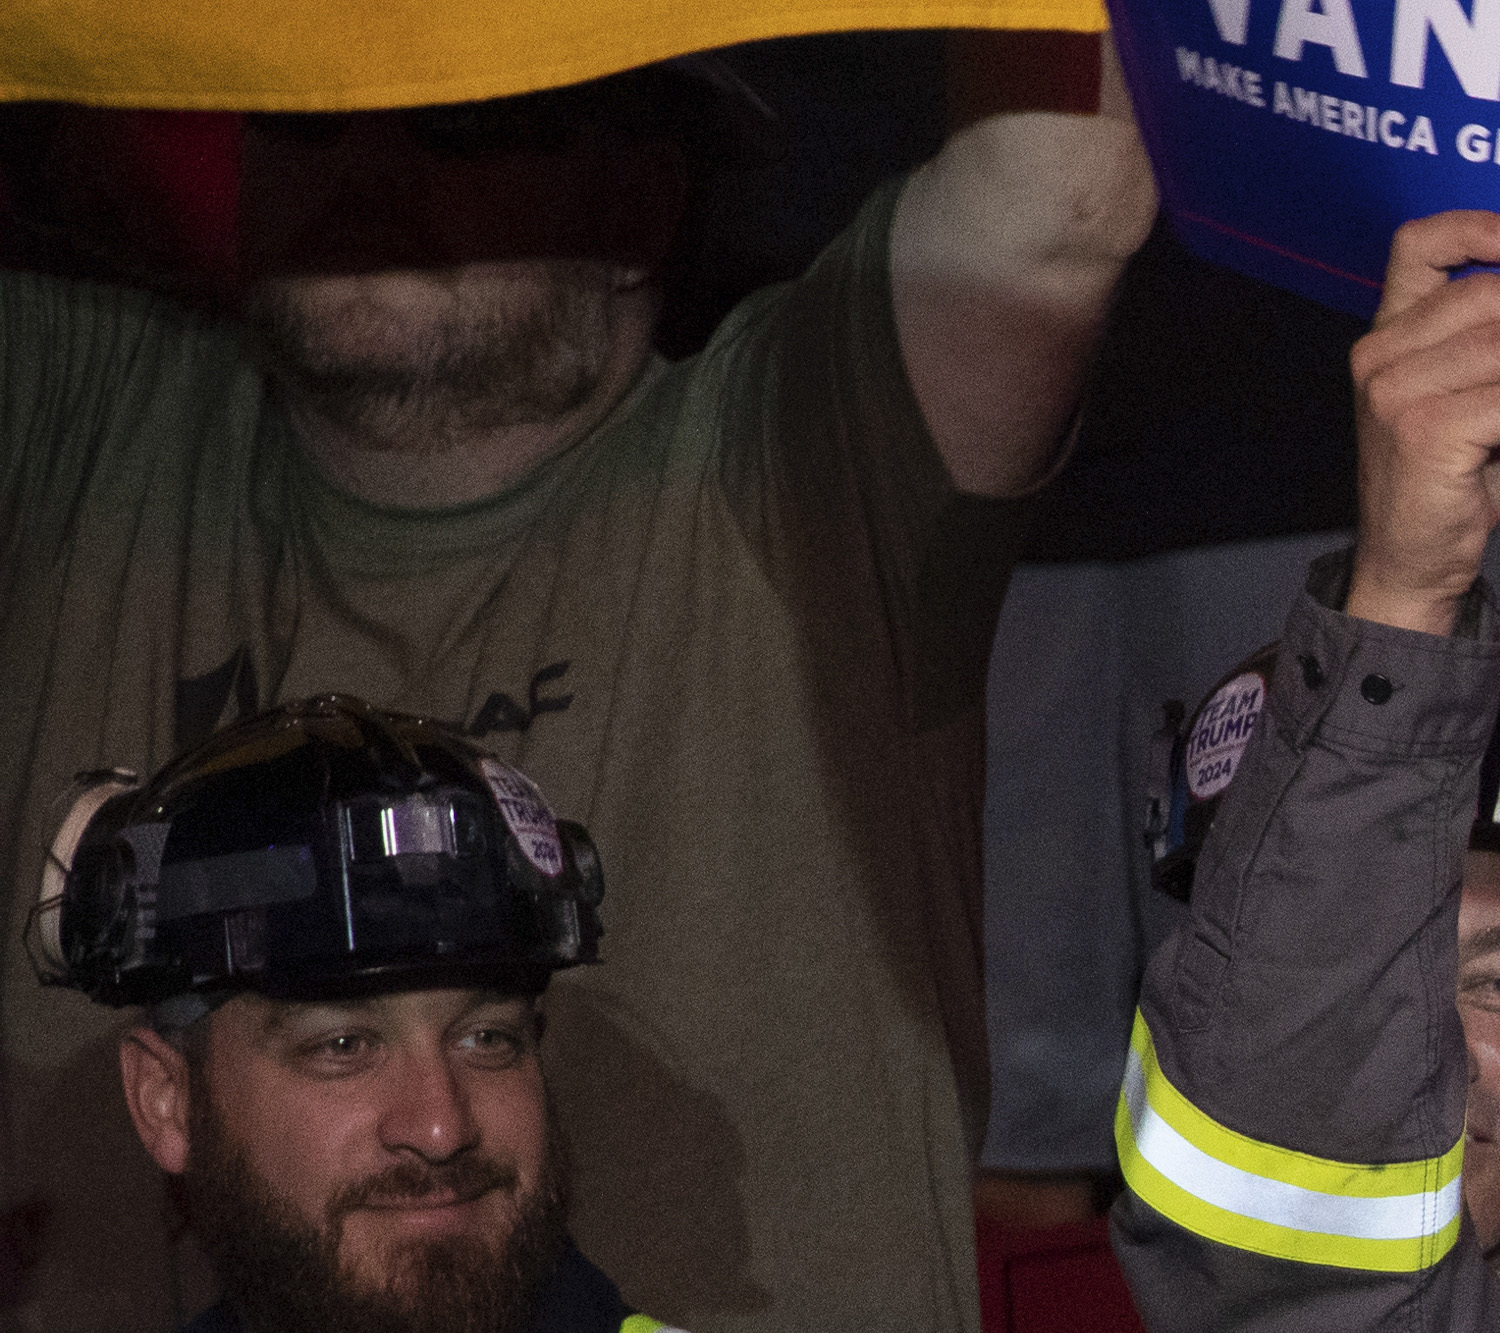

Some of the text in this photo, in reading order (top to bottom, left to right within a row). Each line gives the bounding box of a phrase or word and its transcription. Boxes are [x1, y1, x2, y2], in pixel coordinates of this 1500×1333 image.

[1174, 46, 1266, 108] MAKE
[1272, 80, 1439, 157] AMERICA
[1201, 688, 1261, 729] TEAM
[1189, 712, 1257, 760] TRUMP
[1198, 758, 1231, 786] 2024
